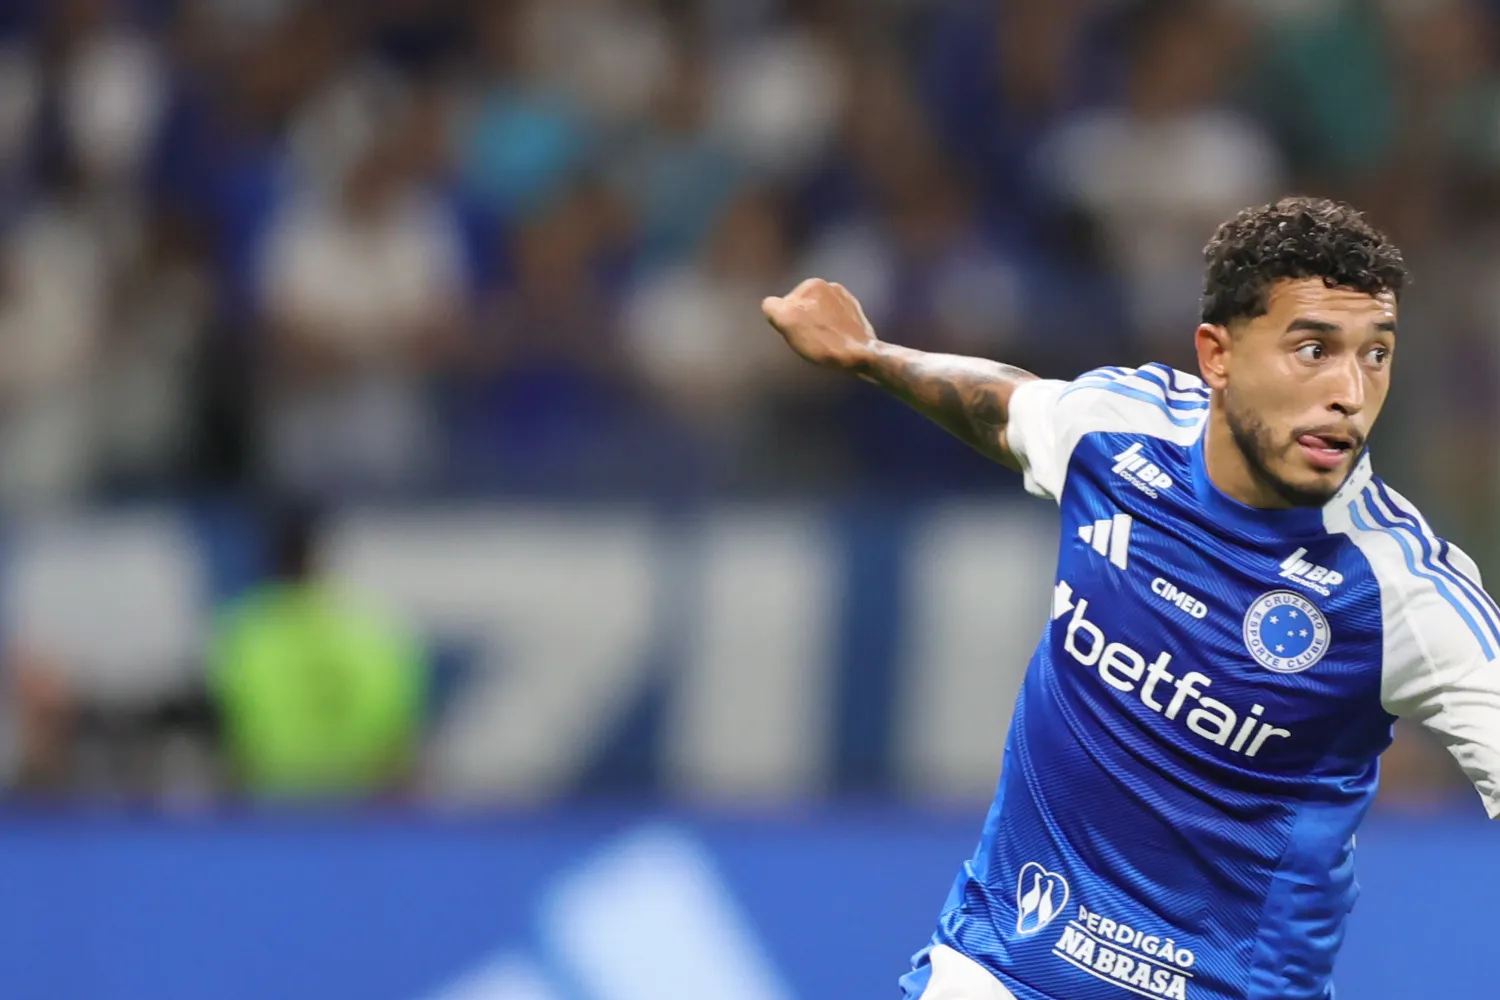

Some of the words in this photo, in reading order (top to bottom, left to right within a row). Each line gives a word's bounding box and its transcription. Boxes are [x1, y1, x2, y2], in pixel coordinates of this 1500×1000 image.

[1151, 577, 1208, 619] CIMED
[1264, 595, 1324, 630] CRUZEIRO
[1248, 611, 1281, 667] ESPORTE
[1286, 637, 1324, 668] CLUBE
[1063, 597, 1292, 758] betfair
[1078, 904, 1195, 968] PERDIGÃO
